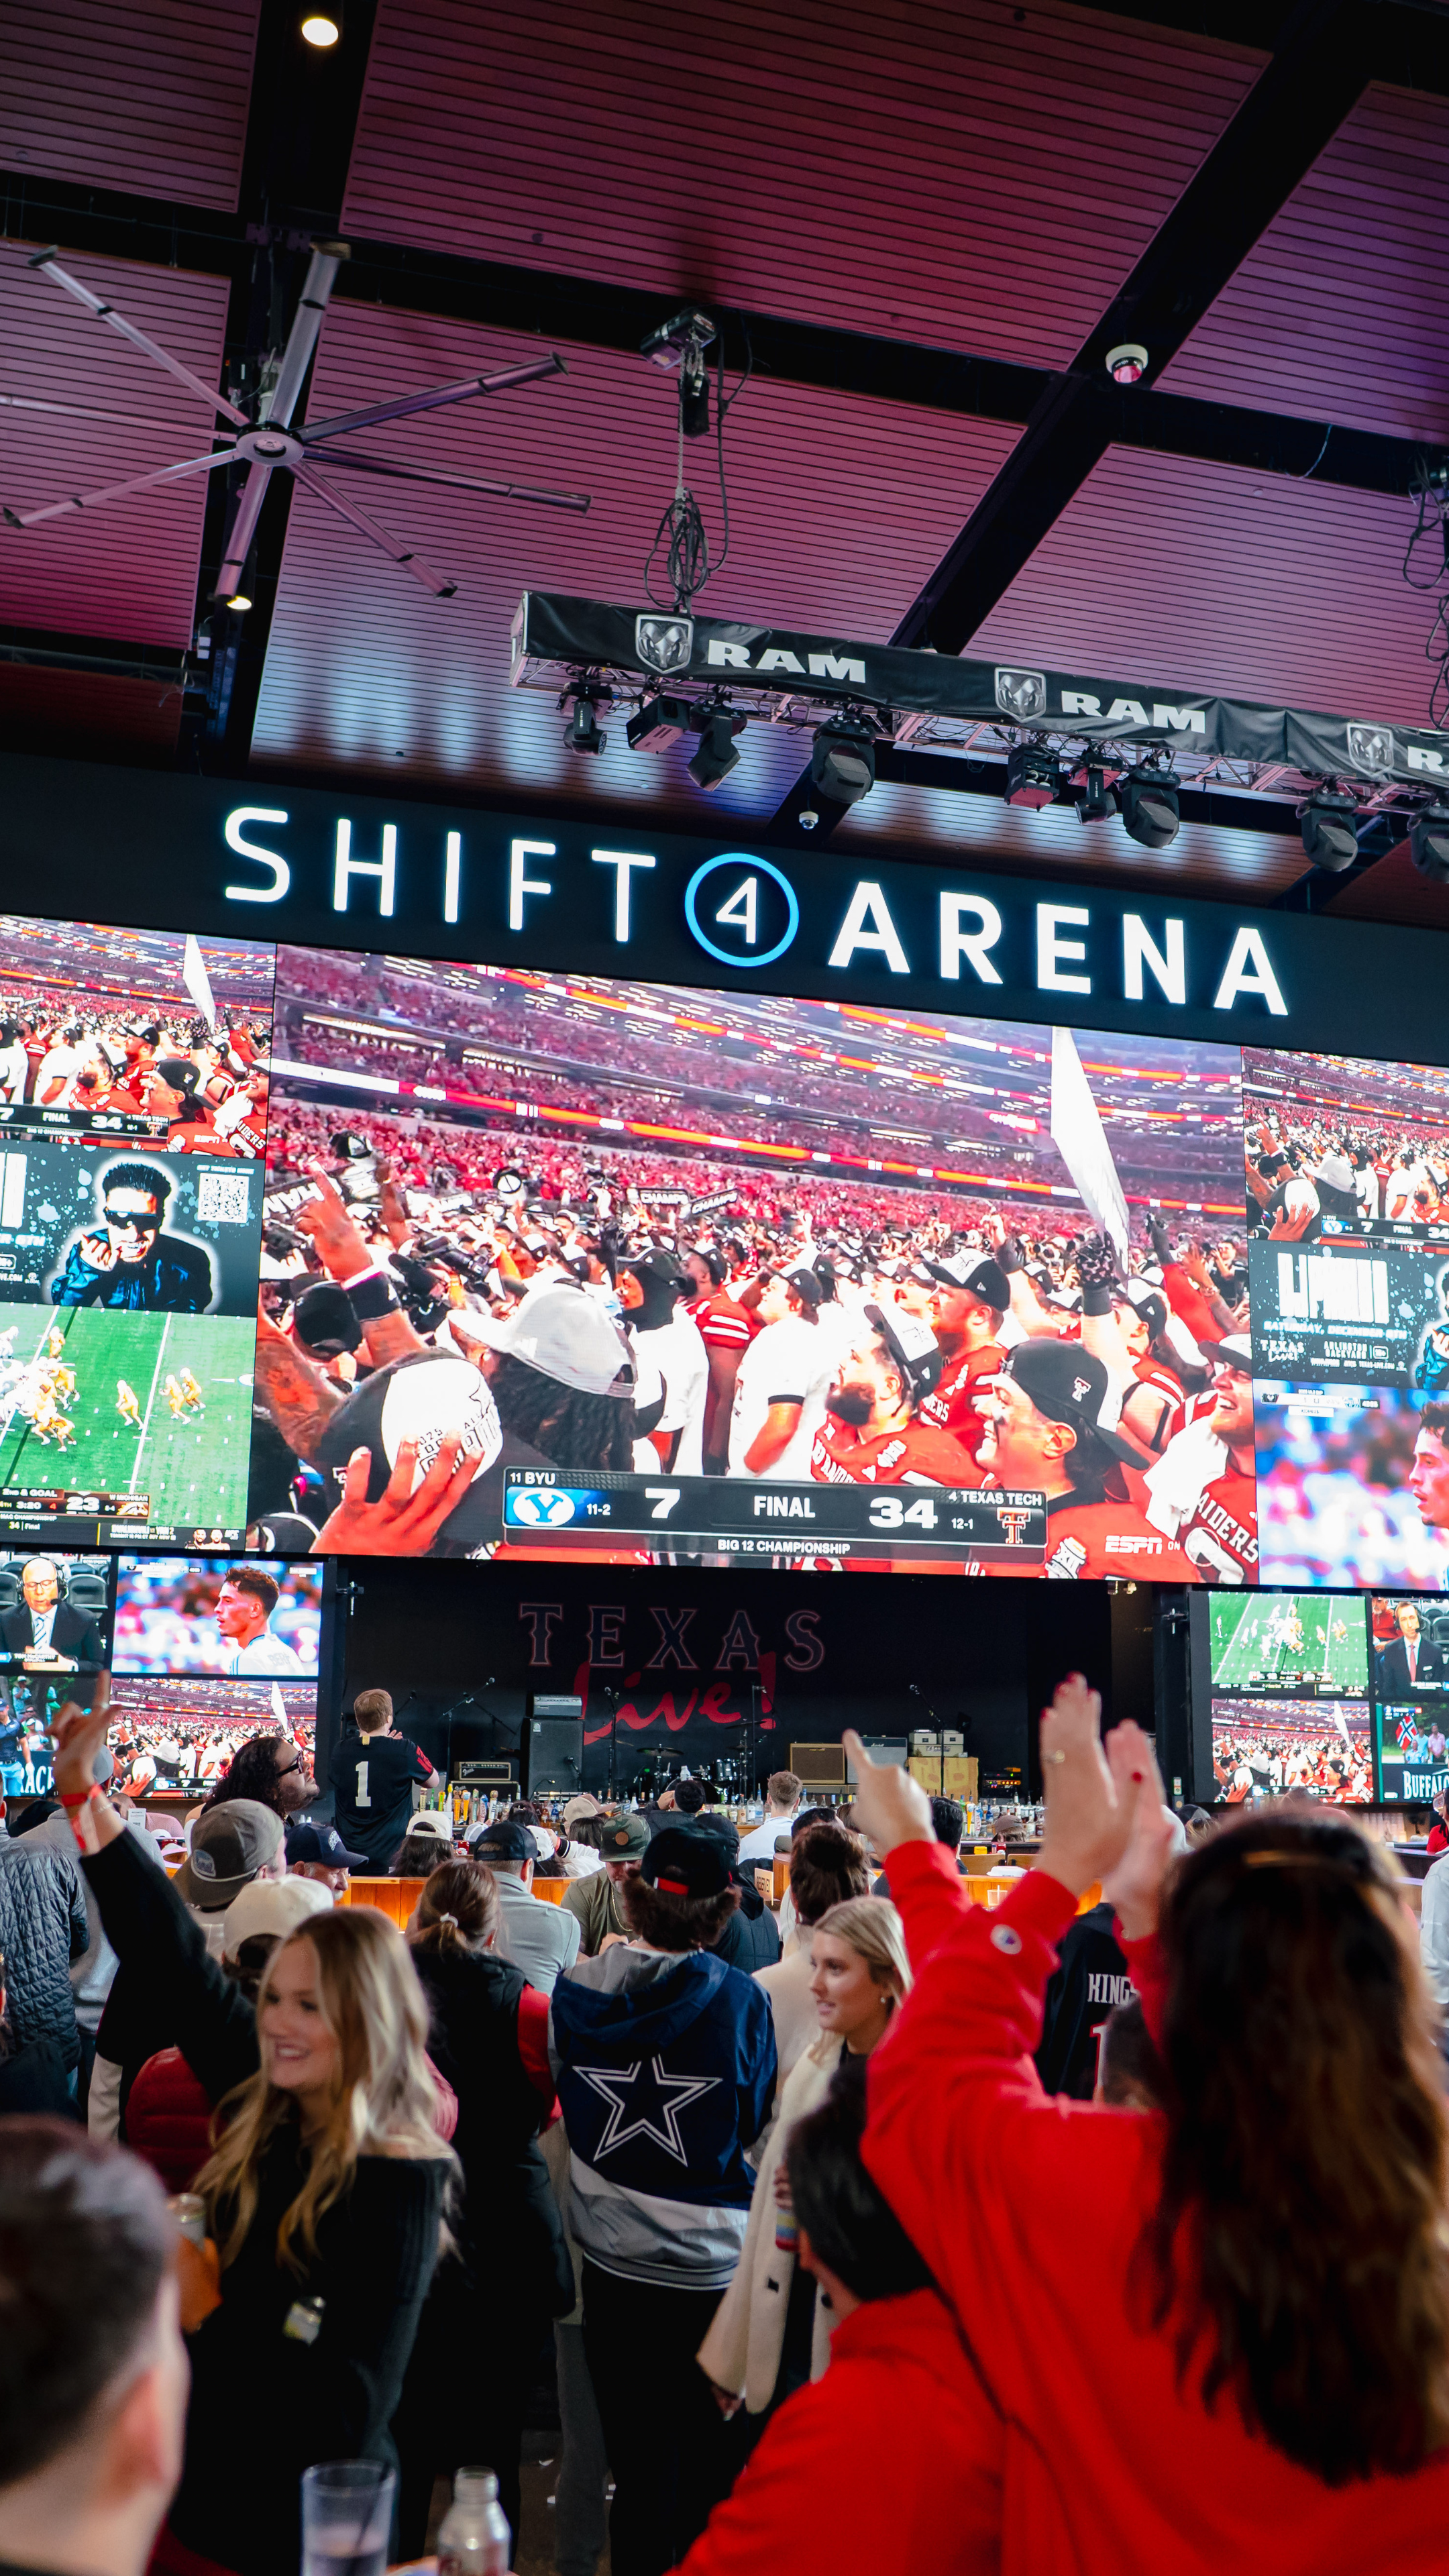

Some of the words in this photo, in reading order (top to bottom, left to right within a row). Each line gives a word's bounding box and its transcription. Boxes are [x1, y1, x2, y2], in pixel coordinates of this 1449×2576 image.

[707, 639, 866, 684] RAM
[1061, 690, 1205, 734] RAM
[1407, 745, 1449, 773] R
[225, 806, 657, 943] SHIFT
[716, 877, 757, 944] 4
[828, 882, 1287, 1015] ARENA
[42, 1112, 70, 1123] FINAL
[91, 1114, 123, 1130] 34
[1361, 1222, 1373, 1233] 7
[1393, 1225, 1414, 1235] FINAL
[1428, 1227, 1449, 1240] 34
[1260, 1338, 1305, 1354] TEXAS
[510, 1472, 521, 1483] 11
[525, 1471, 556, 1485] BYU
[2, 1488, 19, 1497] 2ND
[20, 1489, 28, 1497] &
[29, 1489, 58, 1498] GOAL
[948, 1491, 958, 1502] 4
[960, 1491, 1004, 1505] TEXAS
[1006, 1493, 1042, 1507] TECH
[49, 1502, 57, 1511] 4
[66, 1496, 100, 1512] 23
[586, 1503, 611, 1516] 11-2
[645, 1487, 681, 1519] 7
[754, 1495, 816, 1519] FINAL
[869, 1496, 938, 1529] 34
[9, 1521, 21, 1529] 34
[24, 1523, 41, 1531] Final
[951, 1518, 974, 1530] 12-1
[717, 1539, 740, 1552] BIG
[741, 1540, 755, 1552] 12
[756, 1541, 851, 1555] CHAMPIONSHIP
[1104, 1534, 1163, 1555] ESPN
[1167, 1540, 1181, 1552] ON
[519, 1603, 825, 1672] TEXAS
[355, 1761, 371, 1807] 1
